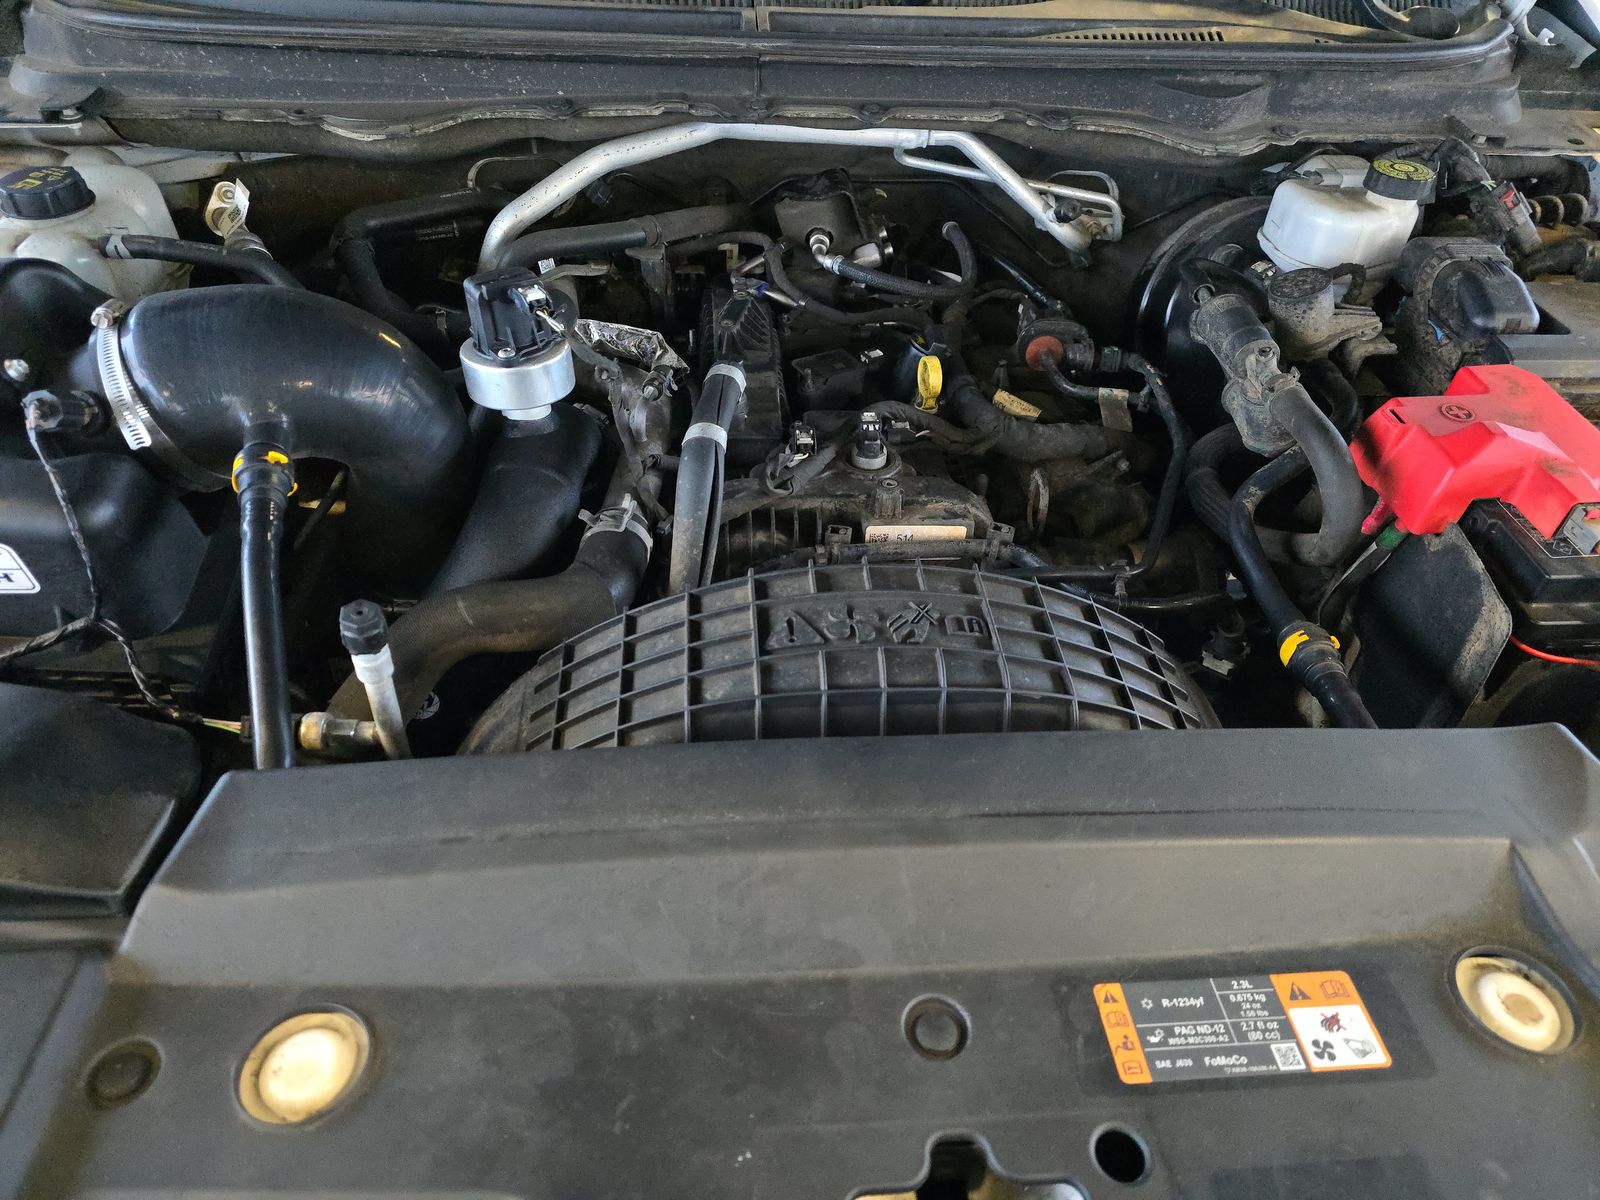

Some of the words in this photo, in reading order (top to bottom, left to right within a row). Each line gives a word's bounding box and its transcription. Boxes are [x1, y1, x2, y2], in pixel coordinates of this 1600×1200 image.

[1231, 980, 1253, 990] 2.3L
[1161, 996, 1205, 1008] R-1234yf
[1253, 992, 1267, 1003] kg
[1174, 1025, 1196, 1036] PAG
[1196, 1023, 1226, 1035] ND-12
[1241, 1021, 1255, 1031] 2.7
[1266, 1020, 1280, 1030] oz
[1264, 1030, 1281, 1041] cc)
[1203, 1054, 1249, 1067] FoMoCo
